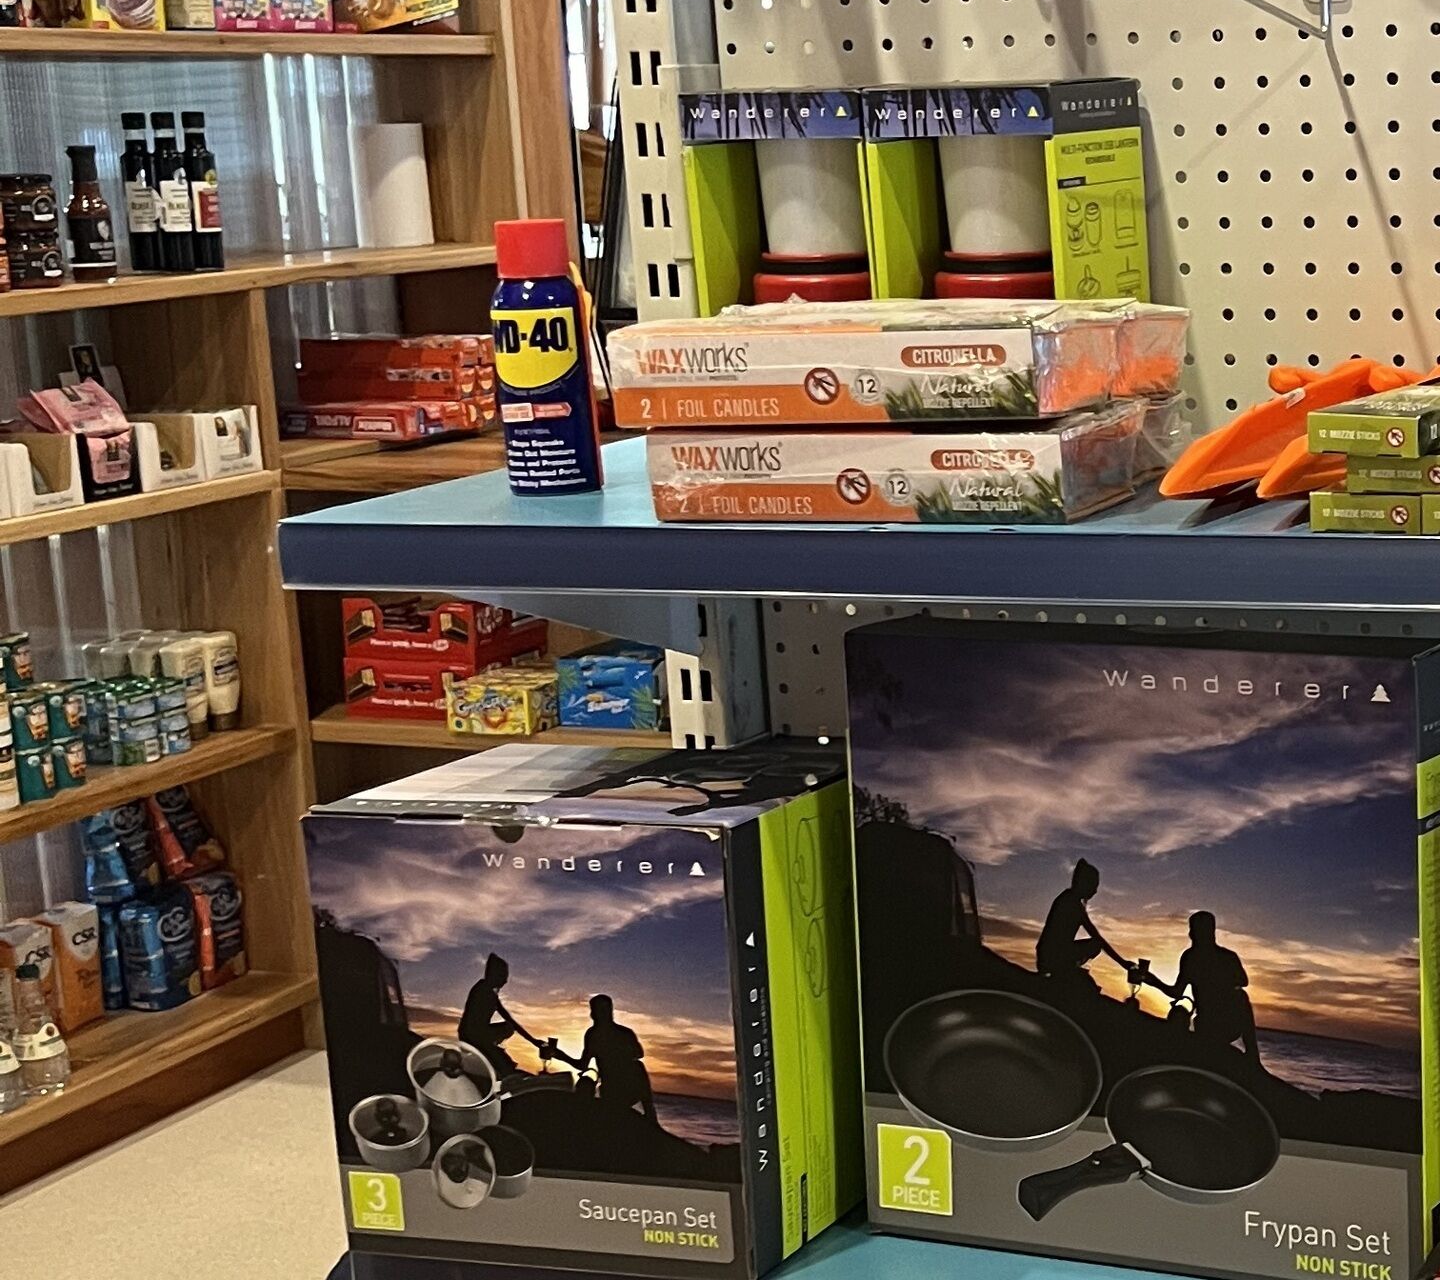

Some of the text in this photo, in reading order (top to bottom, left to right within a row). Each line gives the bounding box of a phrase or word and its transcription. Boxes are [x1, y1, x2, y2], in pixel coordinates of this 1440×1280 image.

[690, 105, 827, 120] Wanderer
[874, 104, 1018, 121] Wanderer
[912, 347, 997, 365] CITRONELLA
[857, 378, 877, 393] 12
[921, 374, 994, 394] Natural
[640, 398, 780, 418] 2 FOIL CANDLES
[671, 441, 782, 471] WAXworks
[888, 479, 907, 495] 12
[950, 479, 1023, 497] Natural
[713, 496, 813, 515] FOIL CANDLES
[1103, 669, 1350, 700] Wanderer
[482, 852, 675, 875] Wanderer
[903, 1135, 931, 1185] 2
[366, 1178, 388, 1212] 3
[892, 1187, 940, 1208] PIECE
[579, 1199, 718, 1230] Saucepan Set
[644, 1229, 719, 1248] NON STICK
[1245, 1210, 1391, 1255] Frypan Set
[1296, 1254, 1335, 1275] NON
